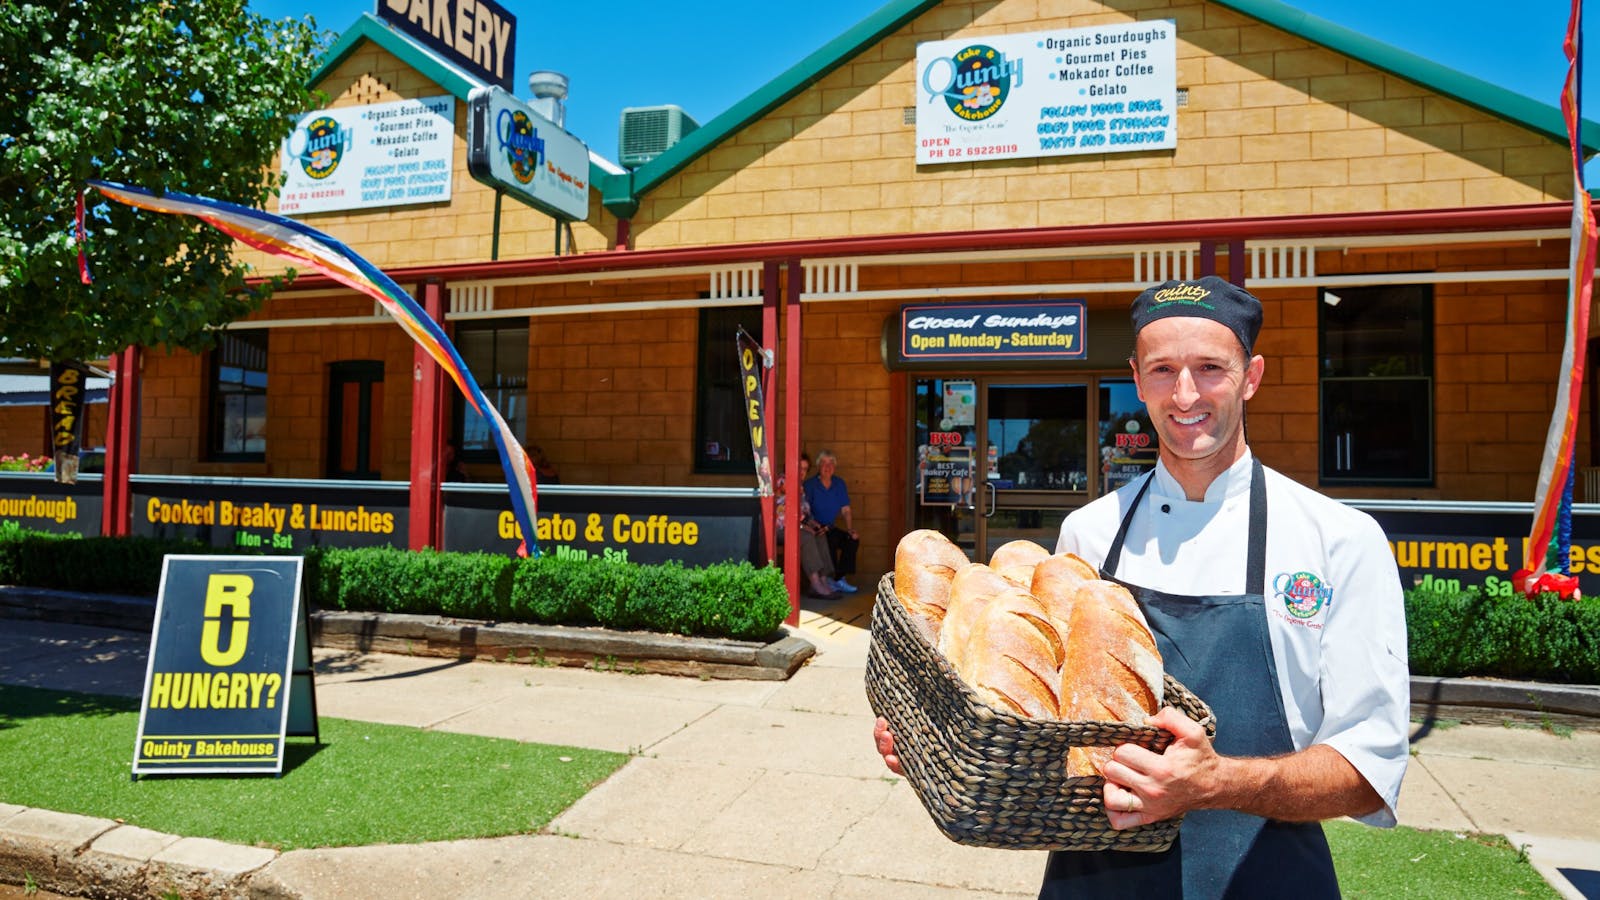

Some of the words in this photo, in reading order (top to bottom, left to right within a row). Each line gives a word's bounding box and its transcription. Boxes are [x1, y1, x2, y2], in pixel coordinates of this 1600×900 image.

[1046, 35, 1091, 51] Organic
[1095, 29, 1166, 45] Sourdoughs
[957, 48, 981, 61] Cake
[986, 49, 995, 59] &
[1066, 51, 1115, 65] Gourmet
[1121, 49, 1147, 60] Pies
[922, 52, 1023, 104] Quinty
[1059, 66, 1110, 80] Mokador
[1116, 64, 1154, 77] Coffee
[1089, 83, 1127, 96] Gelato
[368, 109, 397, 121] Organic
[400, 102, 448, 116] Sourdoughs
[953, 98, 1002, 120] Bakehouse
[1040, 104, 1087, 119] FOLLOW
[1090, 102, 1125, 117] YOUR
[380, 120, 412, 132] Gourmet
[416, 118, 433, 129] Pies
[1037, 121, 1069, 134] OBEY
[1072, 119, 1105, 134] YOUR
[1110, 115, 1170, 130] STOMACH
[287, 122, 353, 165] Quinty
[412, 131, 438, 142] Coffee
[922, 137, 950, 147] OPEN
[1039, 136, 1076, 149] TASTE
[1079, 134, 1106, 147] AND
[394, 147, 419, 158] Gelato
[929, 149, 943, 158] PH
[948, 148, 962, 157] 02
[967, 144, 1018, 156] 69229119
[907, 314, 981, 330] Closed
[983, 313, 1078, 332] Sundays
[911, 334, 945, 351] Open
[55, 368, 80, 446] BREAD
[742, 348, 763, 448] OPEN
[929, 432, 962, 445] BYO
[1116, 433, 1150, 447] BYO
[937, 462, 955, 470] BEST
[1122, 465, 1141, 473] BEST
[0, 495, 76, 523] ourdough
[147, 497, 215, 525] Cooked
[220, 500, 286, 533] Breaky
[289, 503, 305, 530] &
[310, 504, 394, 533] Lunches
[584, 512, 604, 542] &
[612, 513, 699, 545] Coffee
[236, 531, 261, 547] Mon
[272, 533, 293, 549] Sat
[556, 545, 588, 562] Mon
[603, 547, 628, 565] Sat
[1388, 536, 1509, 571] urmet
[204, 574, 254, 618] R
[1273, 572, 1333, 606] Quinty
[1484, 576, 1514, 597] Sa
[200, 620, 249, 667] U
[150, 672, 282, 709] HUNGRY?
[143, 741, 192, 759] Quinty
[195, 741, 274, 755] Bakehouse
